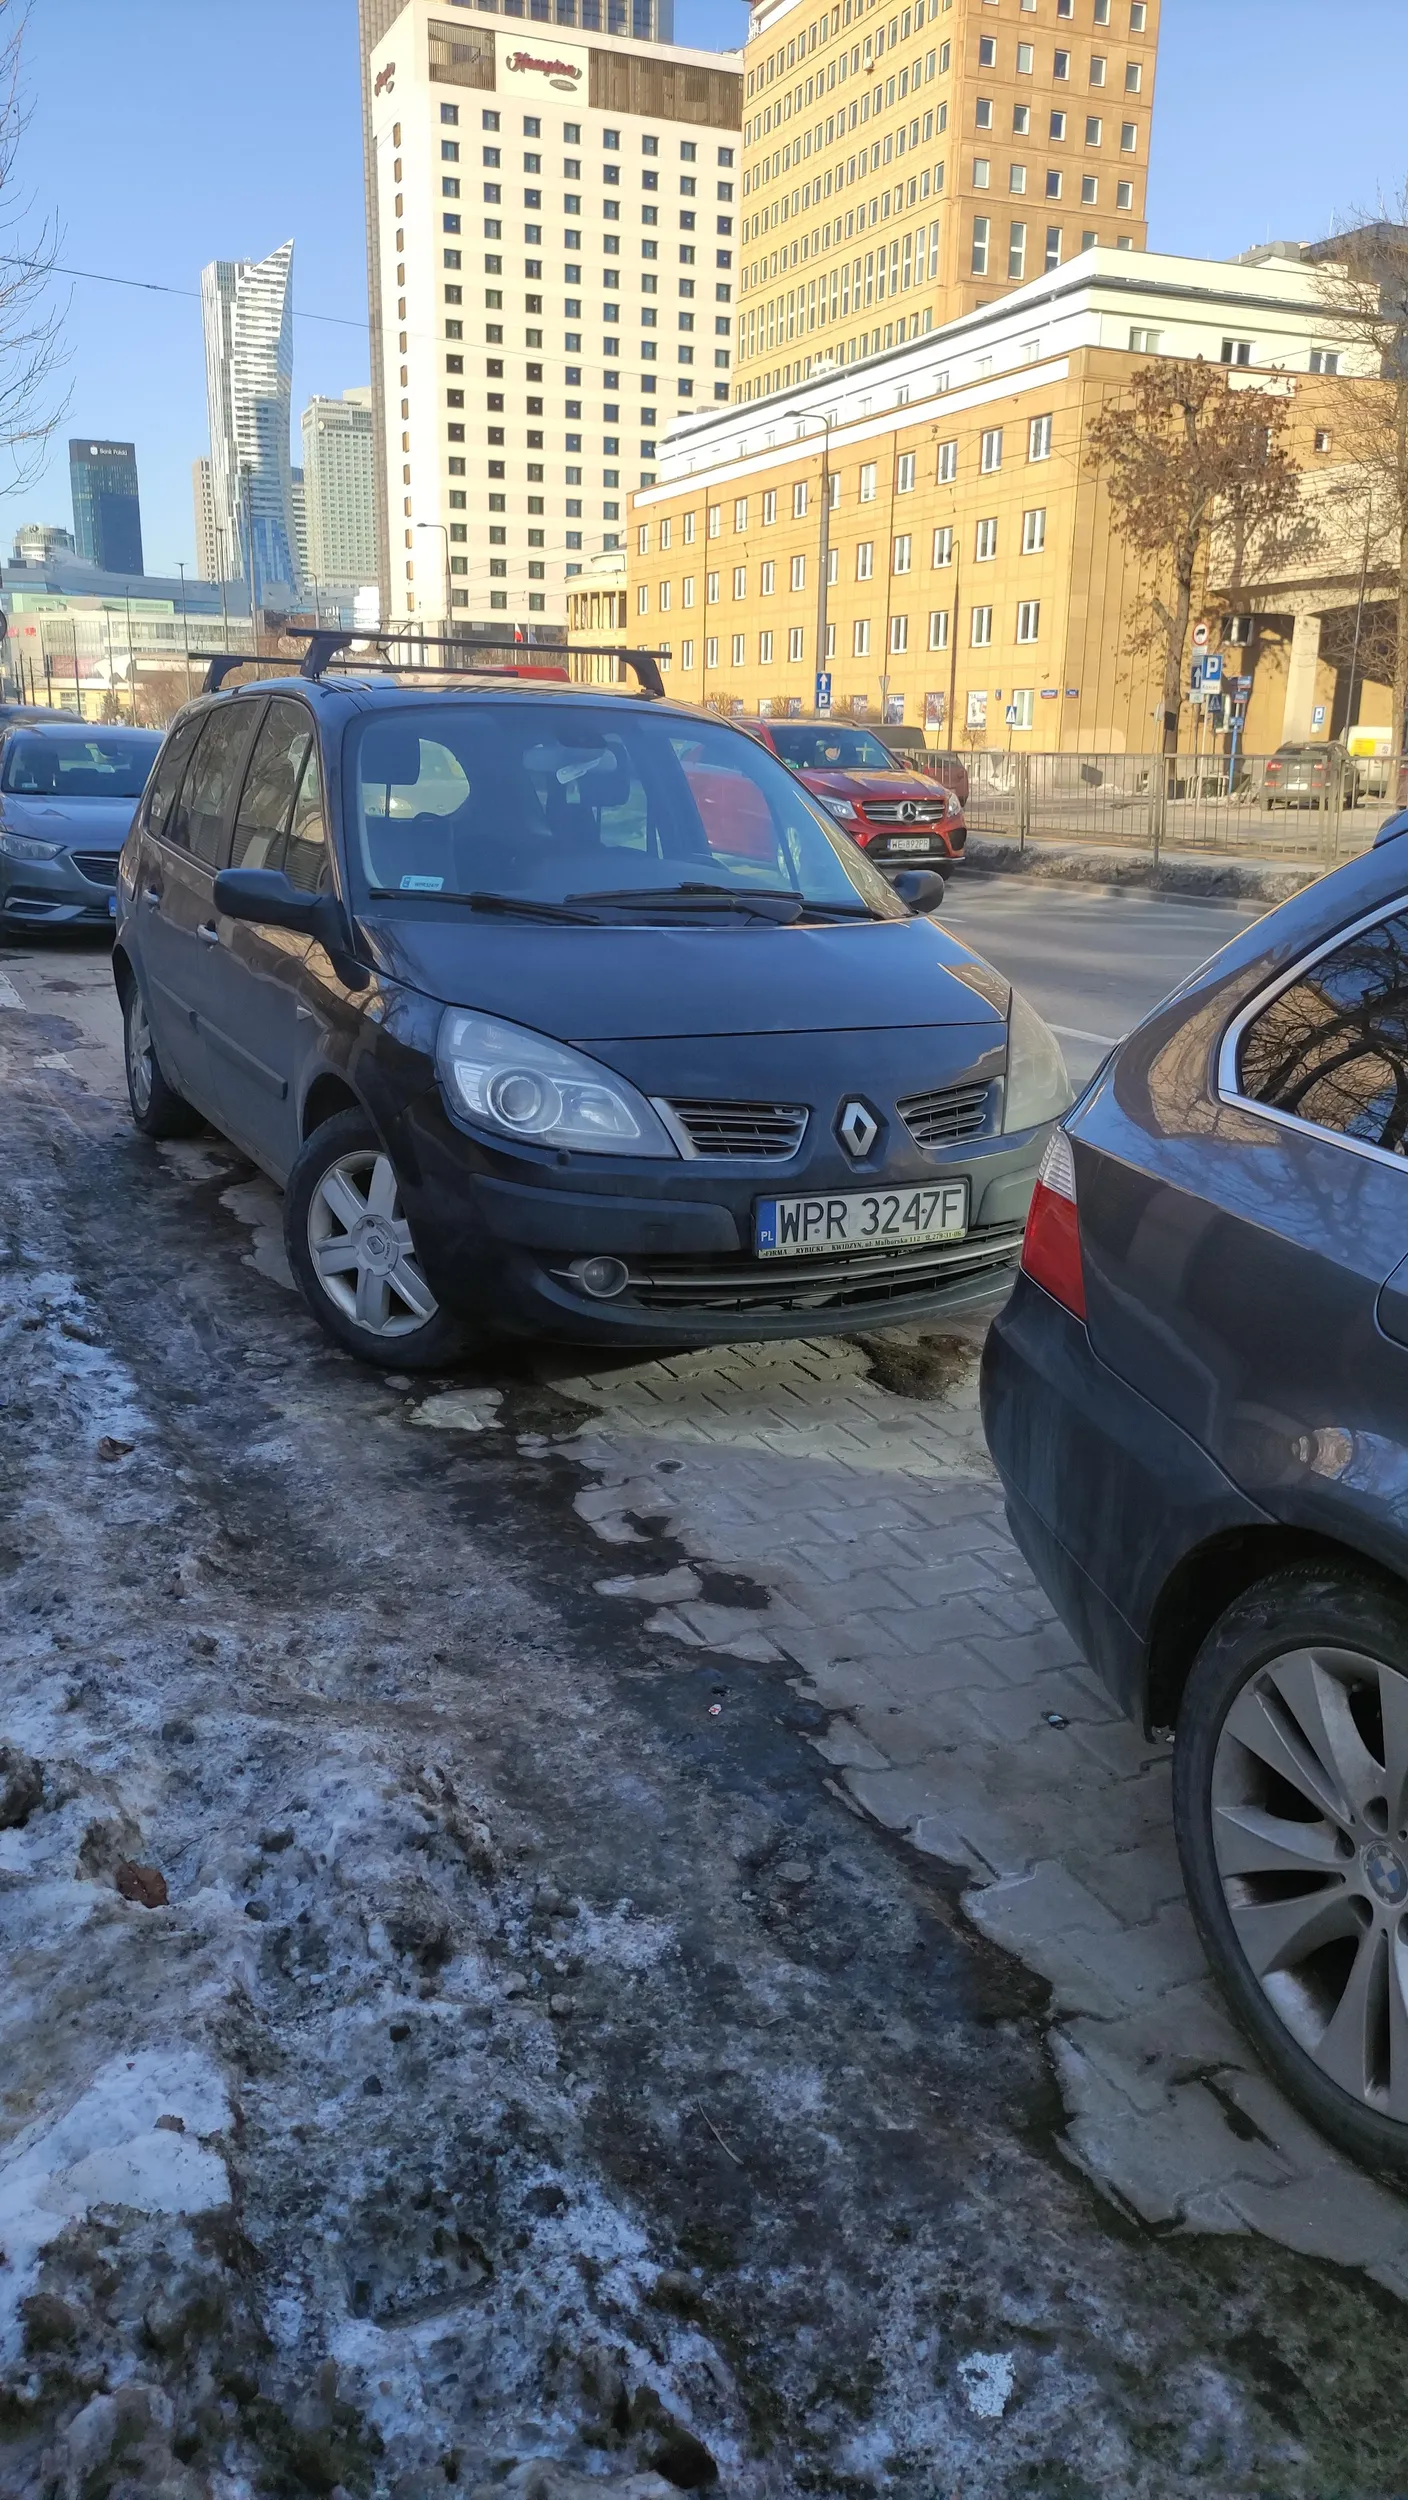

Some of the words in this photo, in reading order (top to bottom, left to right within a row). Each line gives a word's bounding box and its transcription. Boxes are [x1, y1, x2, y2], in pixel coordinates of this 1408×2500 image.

[1206, 657, 1219, 678] P
[780, 1201, 847, 1244] WPR
[861, 1189, 962, 1235] 3247F
[761, 1231, 774, 1242] PL
[795, 1246, 824, 1254] RYBICKI
